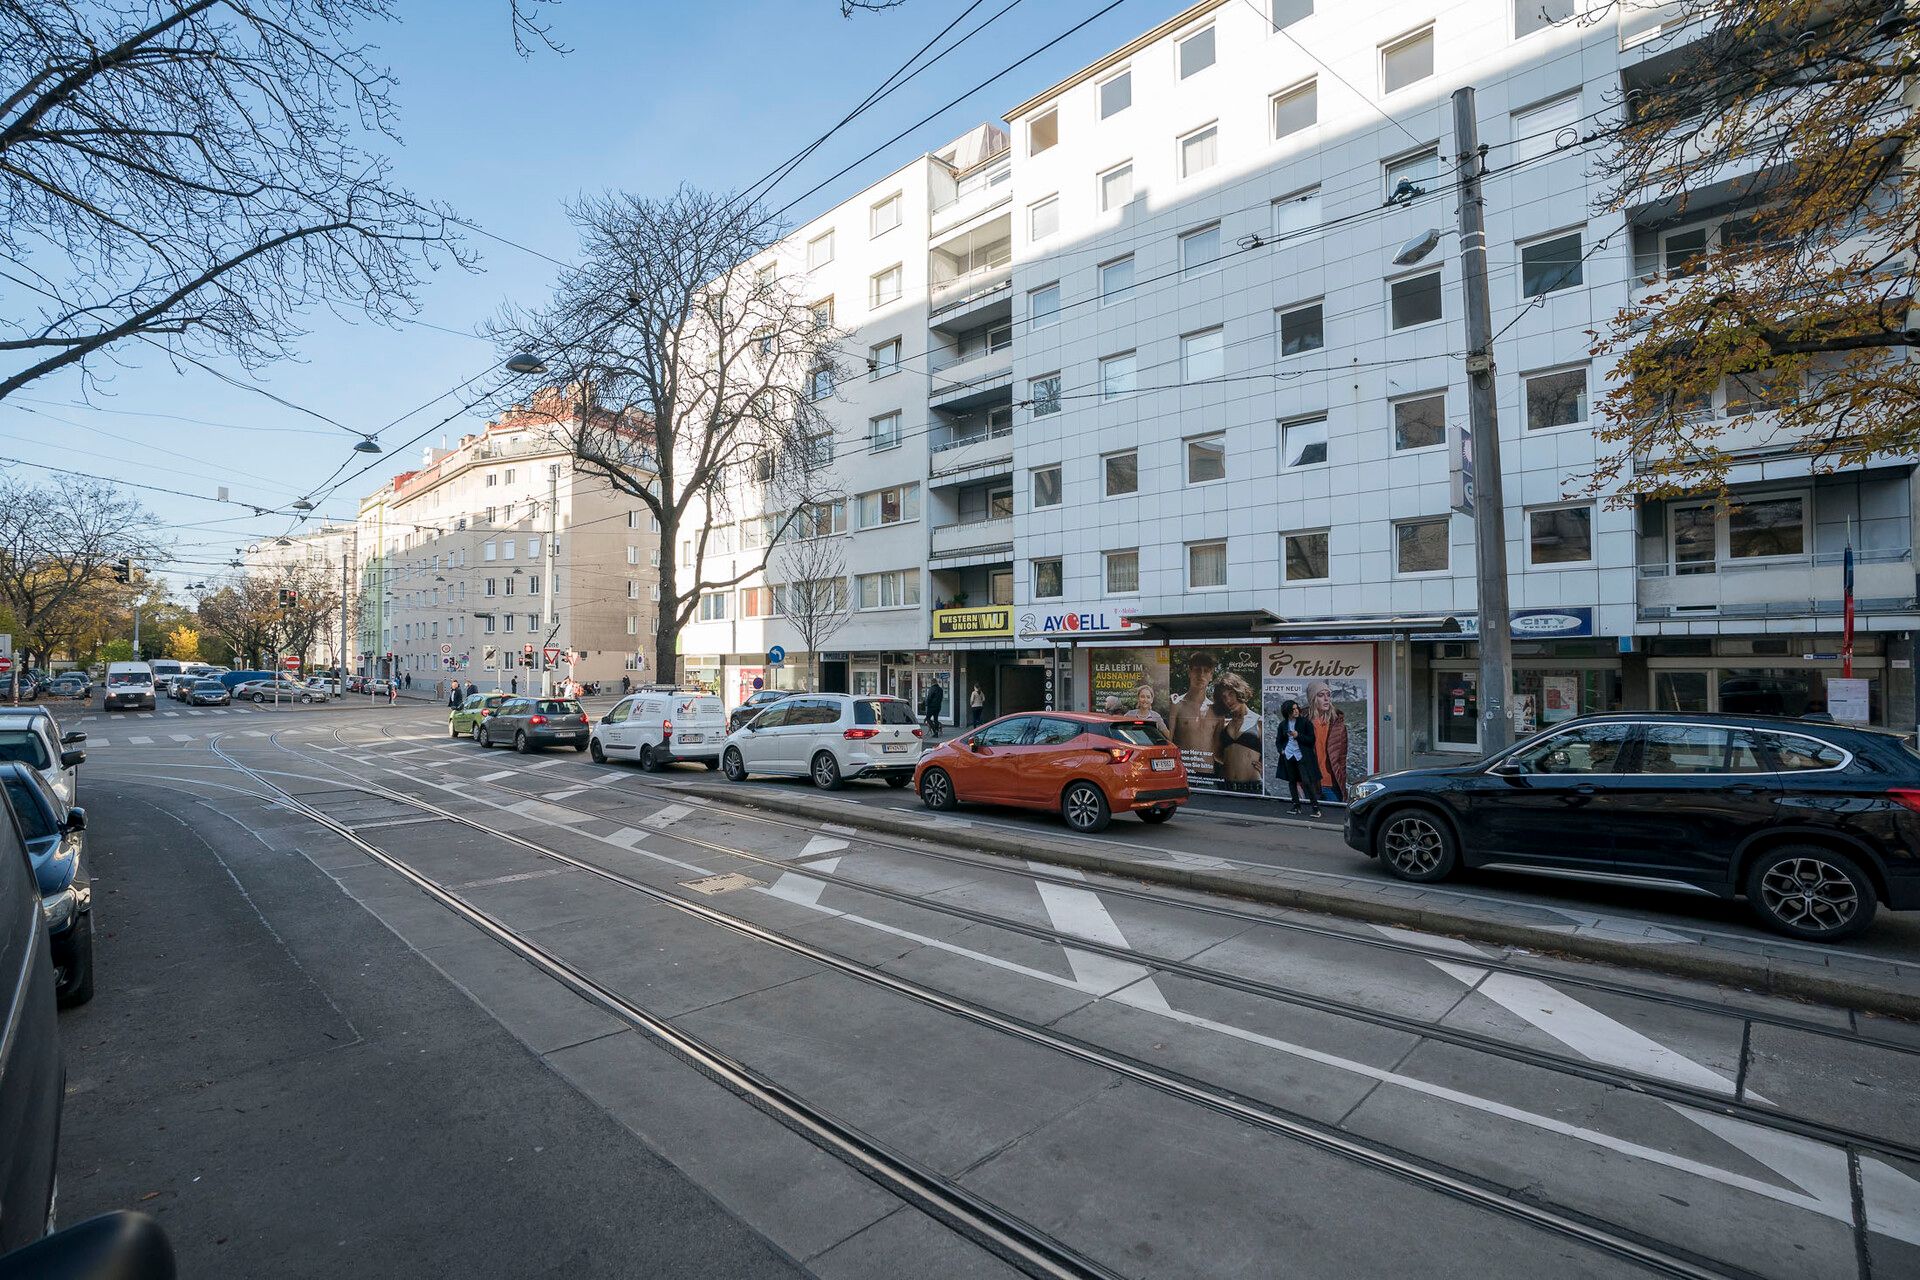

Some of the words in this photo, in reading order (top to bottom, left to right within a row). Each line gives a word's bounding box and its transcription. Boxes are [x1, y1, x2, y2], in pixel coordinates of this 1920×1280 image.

[941, 614, 978, 624] WESTERN
[1520, 617, 1569, 626] CITY
[952, 622, 978, 631] UNION
[1095, 664, 1111, 672] LEA
[1112, 664, 1132, 672] LEBT
[1132, 664, 1144, 672] IM
[1293, 660, 1360, 677] Tchibo
[1095, 672, 1145, 681] AUSNAHME-
